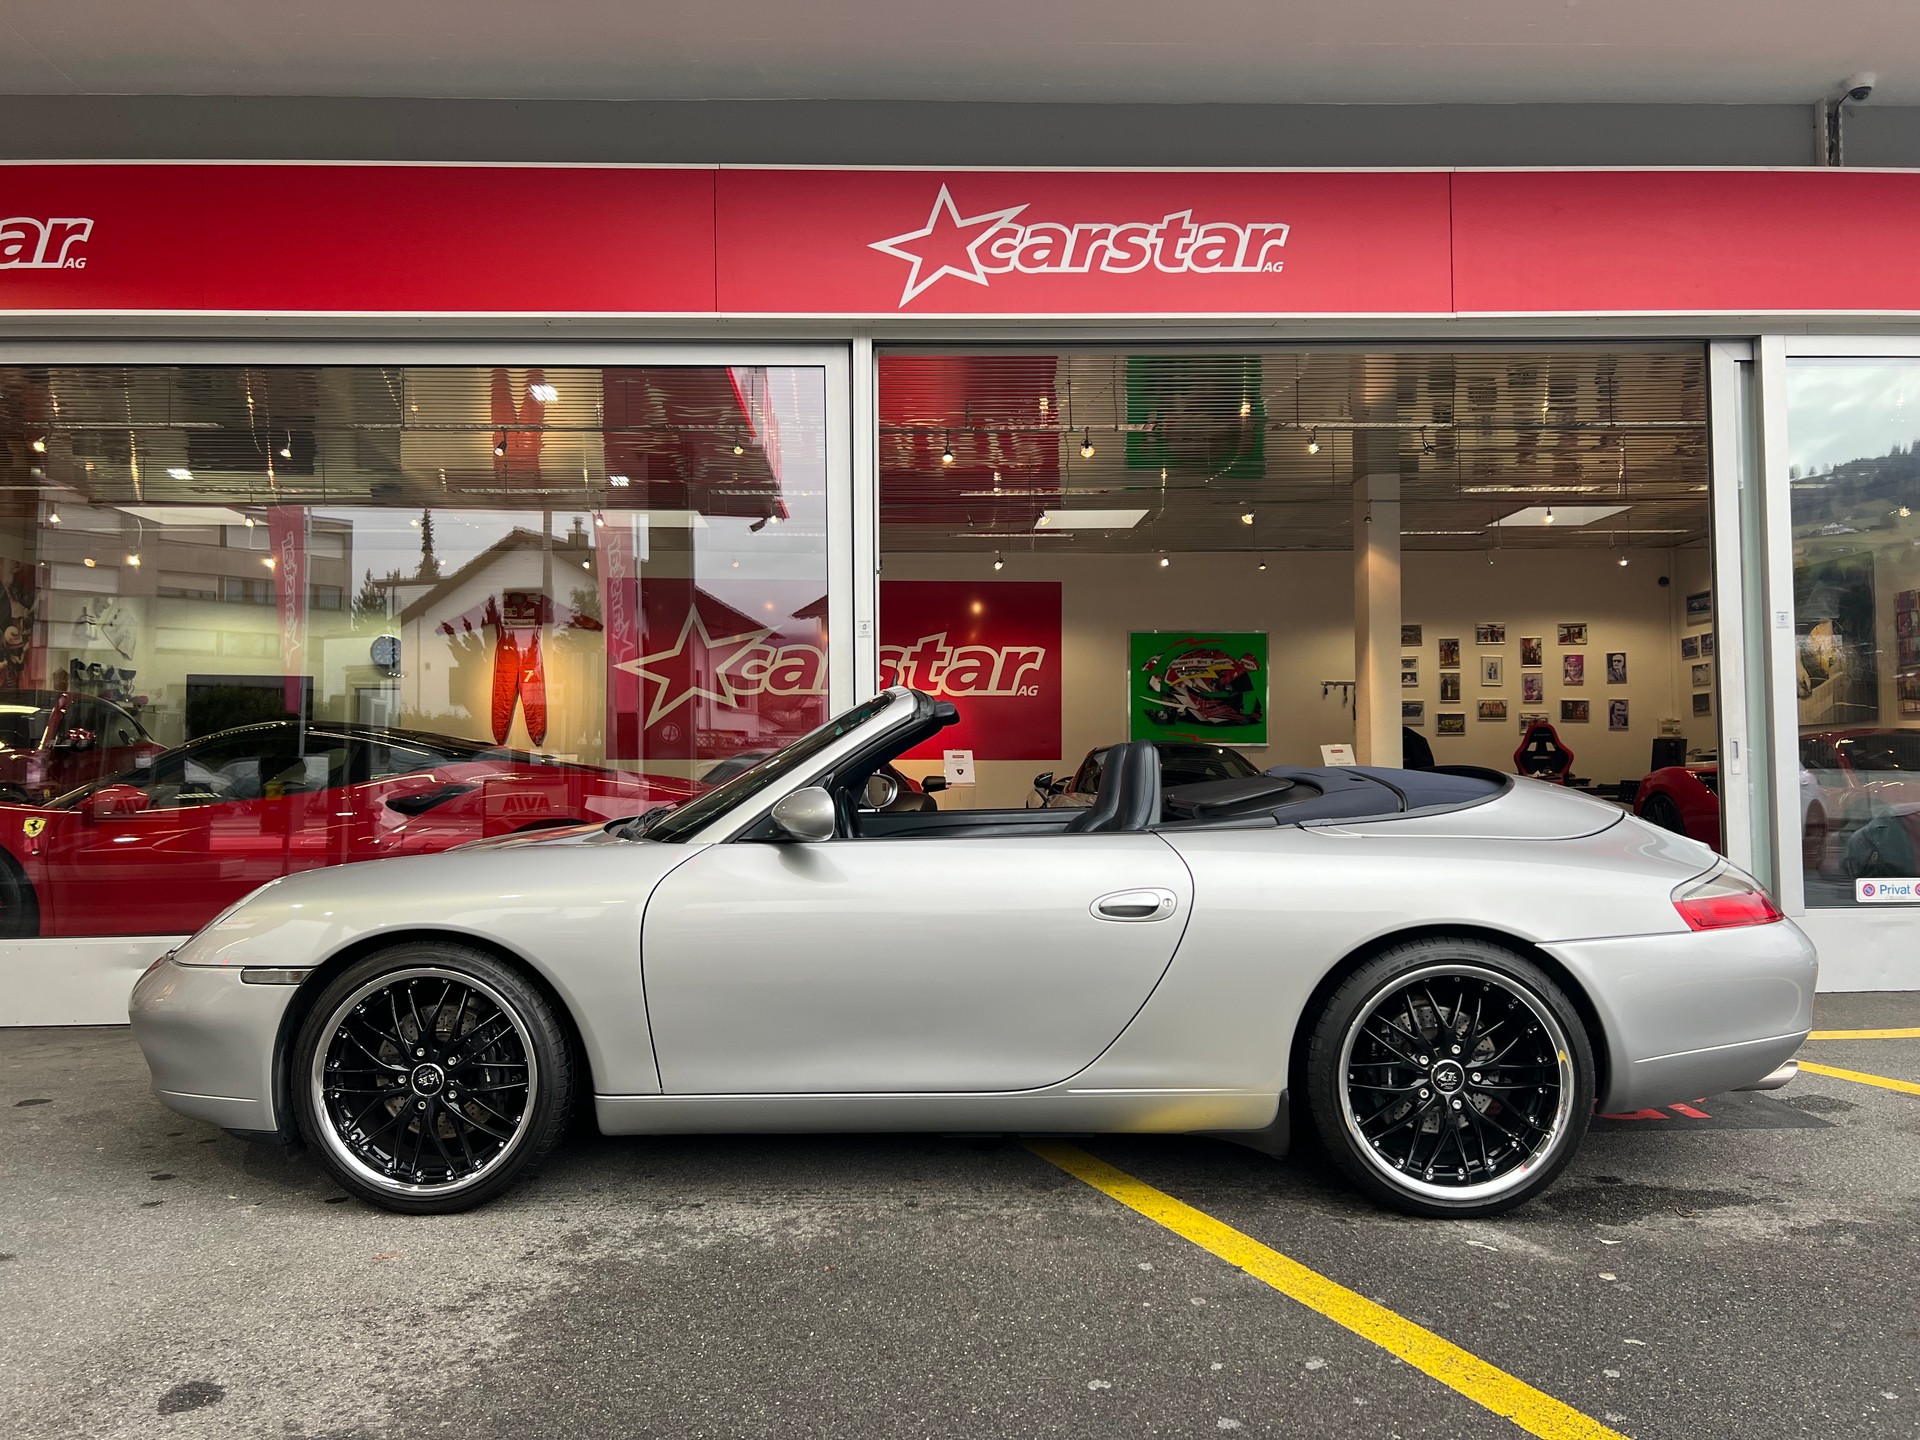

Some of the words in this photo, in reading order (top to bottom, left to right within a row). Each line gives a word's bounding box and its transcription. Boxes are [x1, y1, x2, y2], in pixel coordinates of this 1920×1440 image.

[974, 209, 1290, 274] carstar
[1262, 261, 1284, 273] AG
[63, 257, 87, 269] AG
[720, 632, 1046, 697] catar
[1016, 685, 1039, 697] AG
[523, 669, 535, 683] 7
[1879, 884, 1911, 895] Privat
